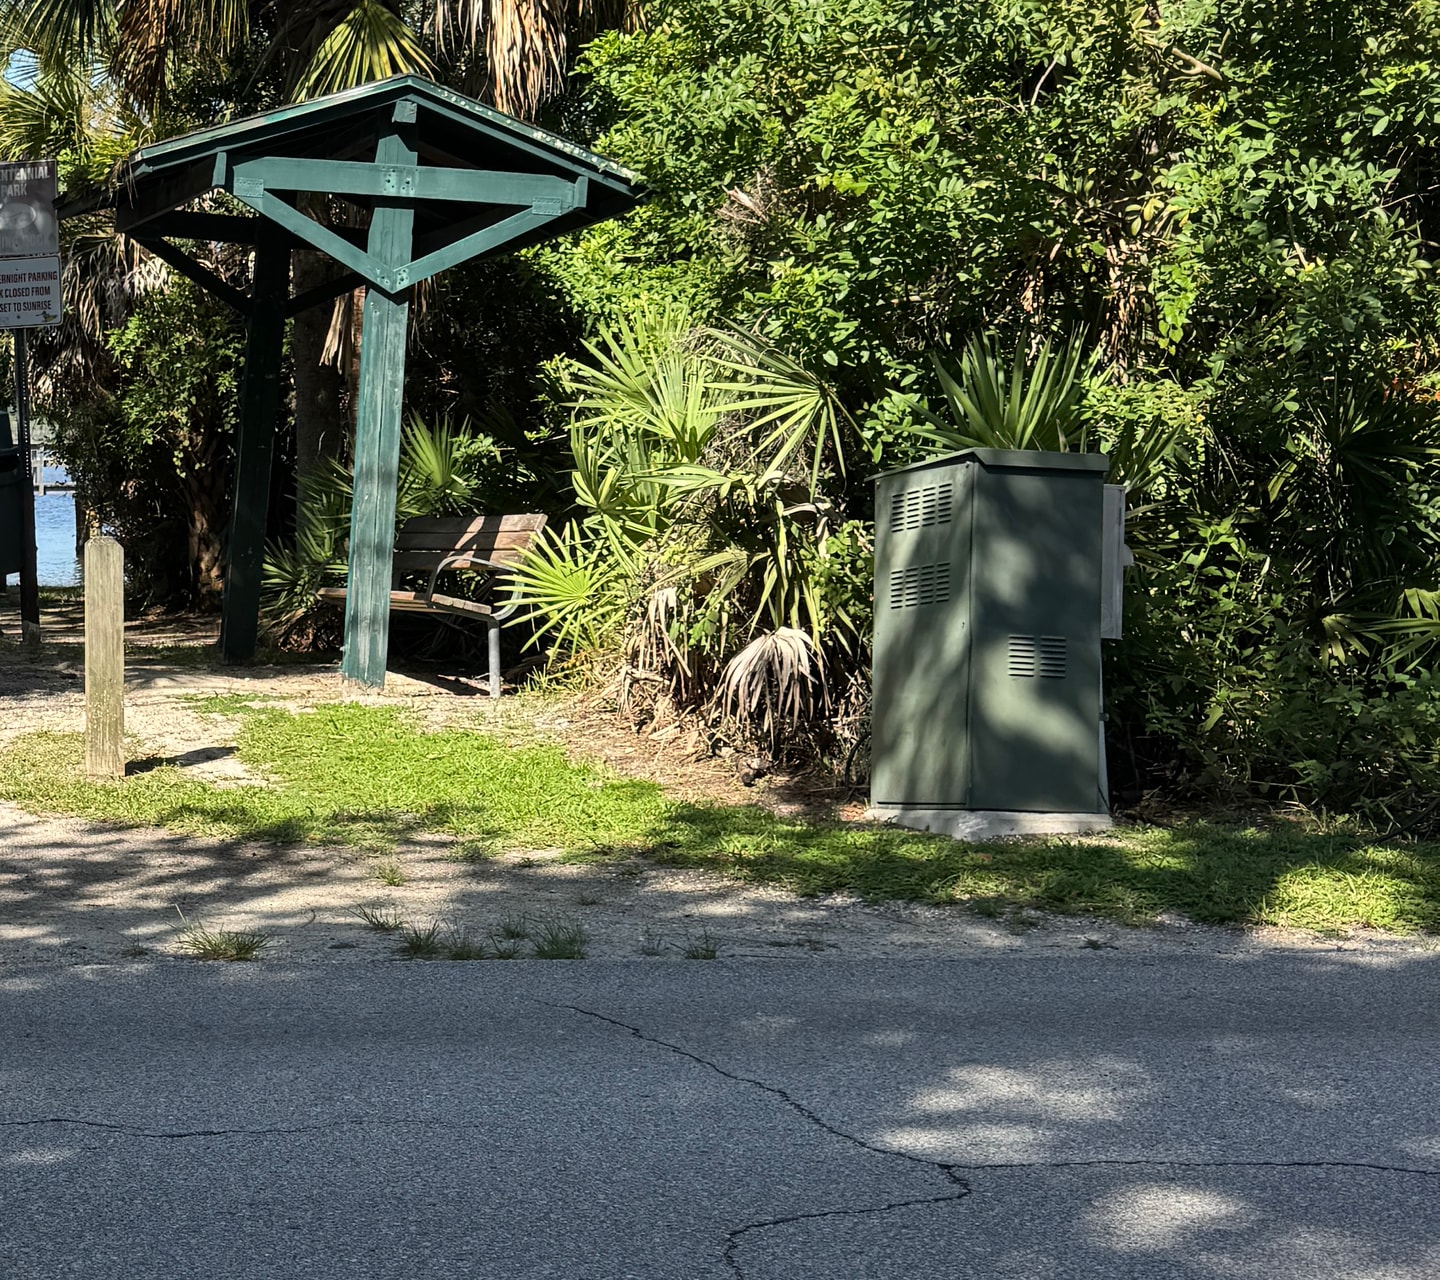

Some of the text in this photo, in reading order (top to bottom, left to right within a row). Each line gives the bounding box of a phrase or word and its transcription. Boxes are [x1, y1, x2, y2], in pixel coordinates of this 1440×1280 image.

[1, 183, 27, 197] PARK
[28, 271, 57, 281] PARKING
[5, 287, 30, 298] CLOSED
[31, 286, 50, 296] FROM
[13, 302, 21, 312] TO
[23, 300, 51, 311] SUNRISE
